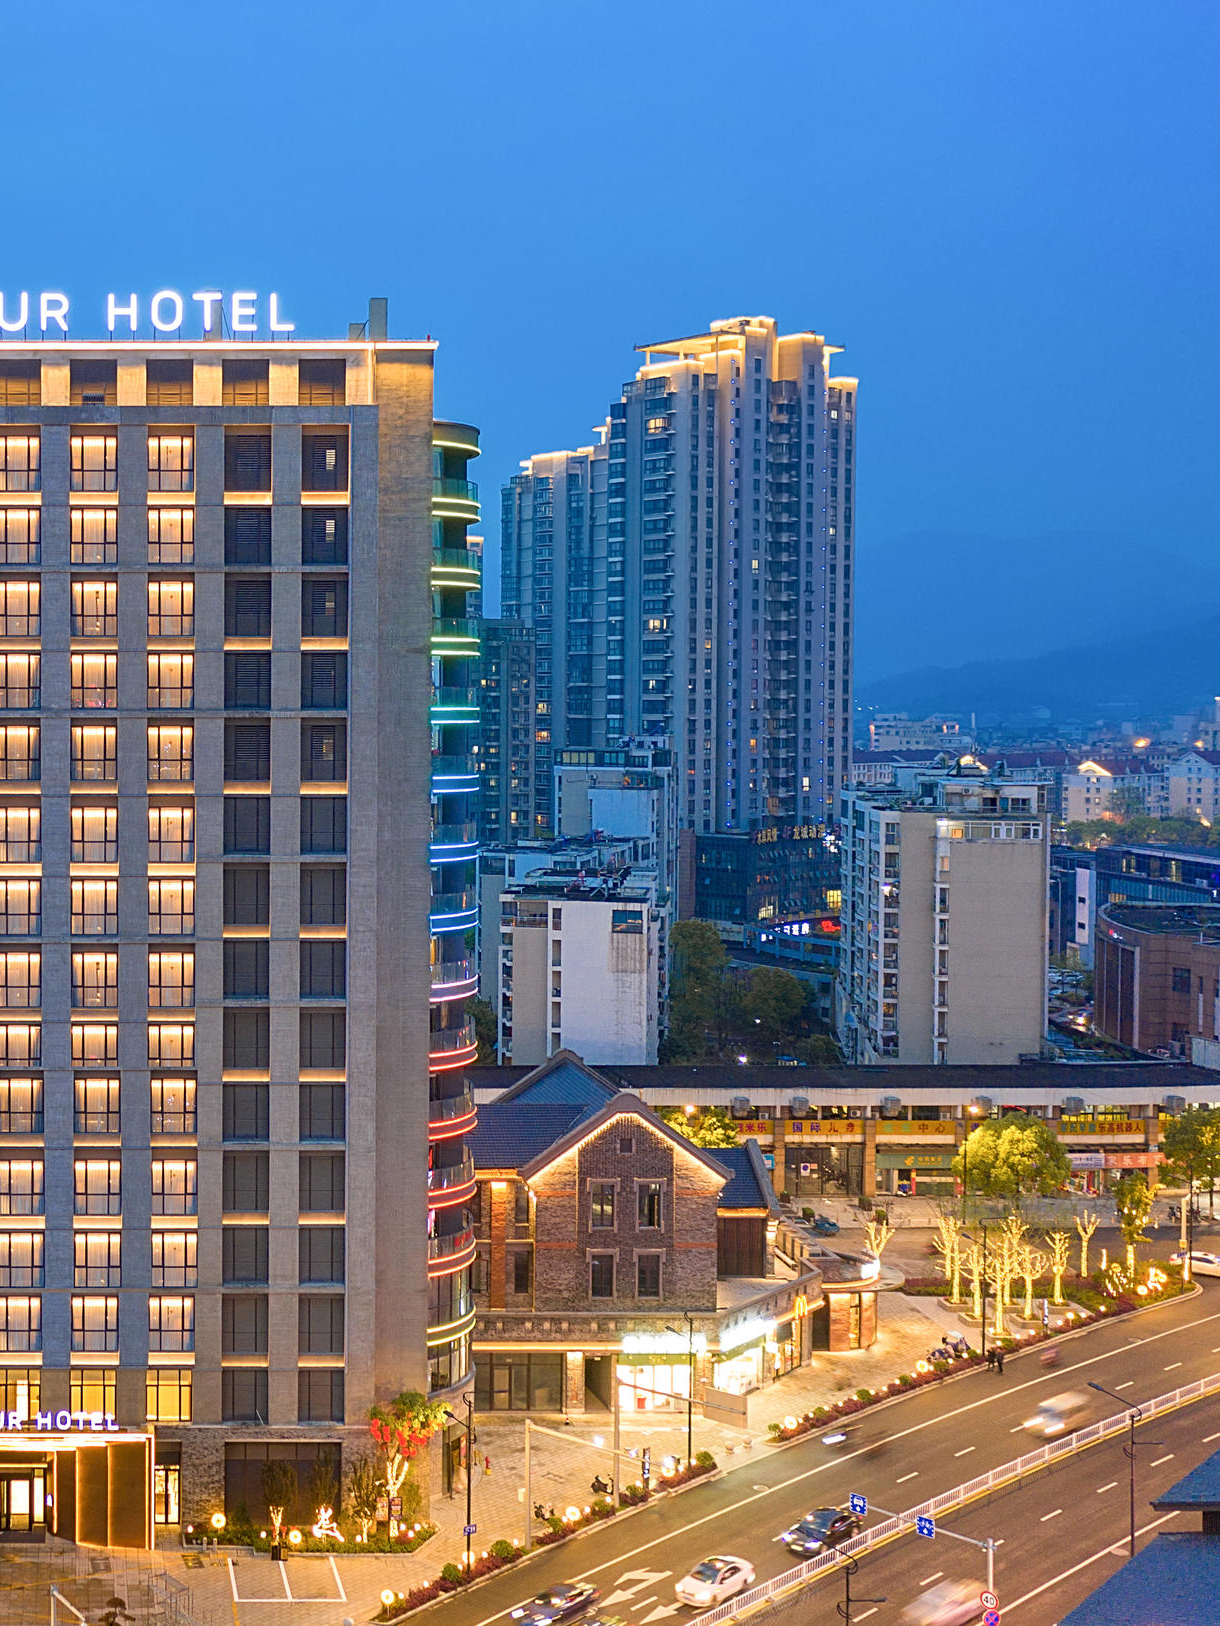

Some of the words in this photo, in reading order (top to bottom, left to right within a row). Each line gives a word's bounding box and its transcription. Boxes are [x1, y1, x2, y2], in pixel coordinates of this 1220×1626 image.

[107, 290, 296, 332] HOTEL
[36, 1409, 120, 1431] HOTEL
[983, 1596, 994, 1605] 40
